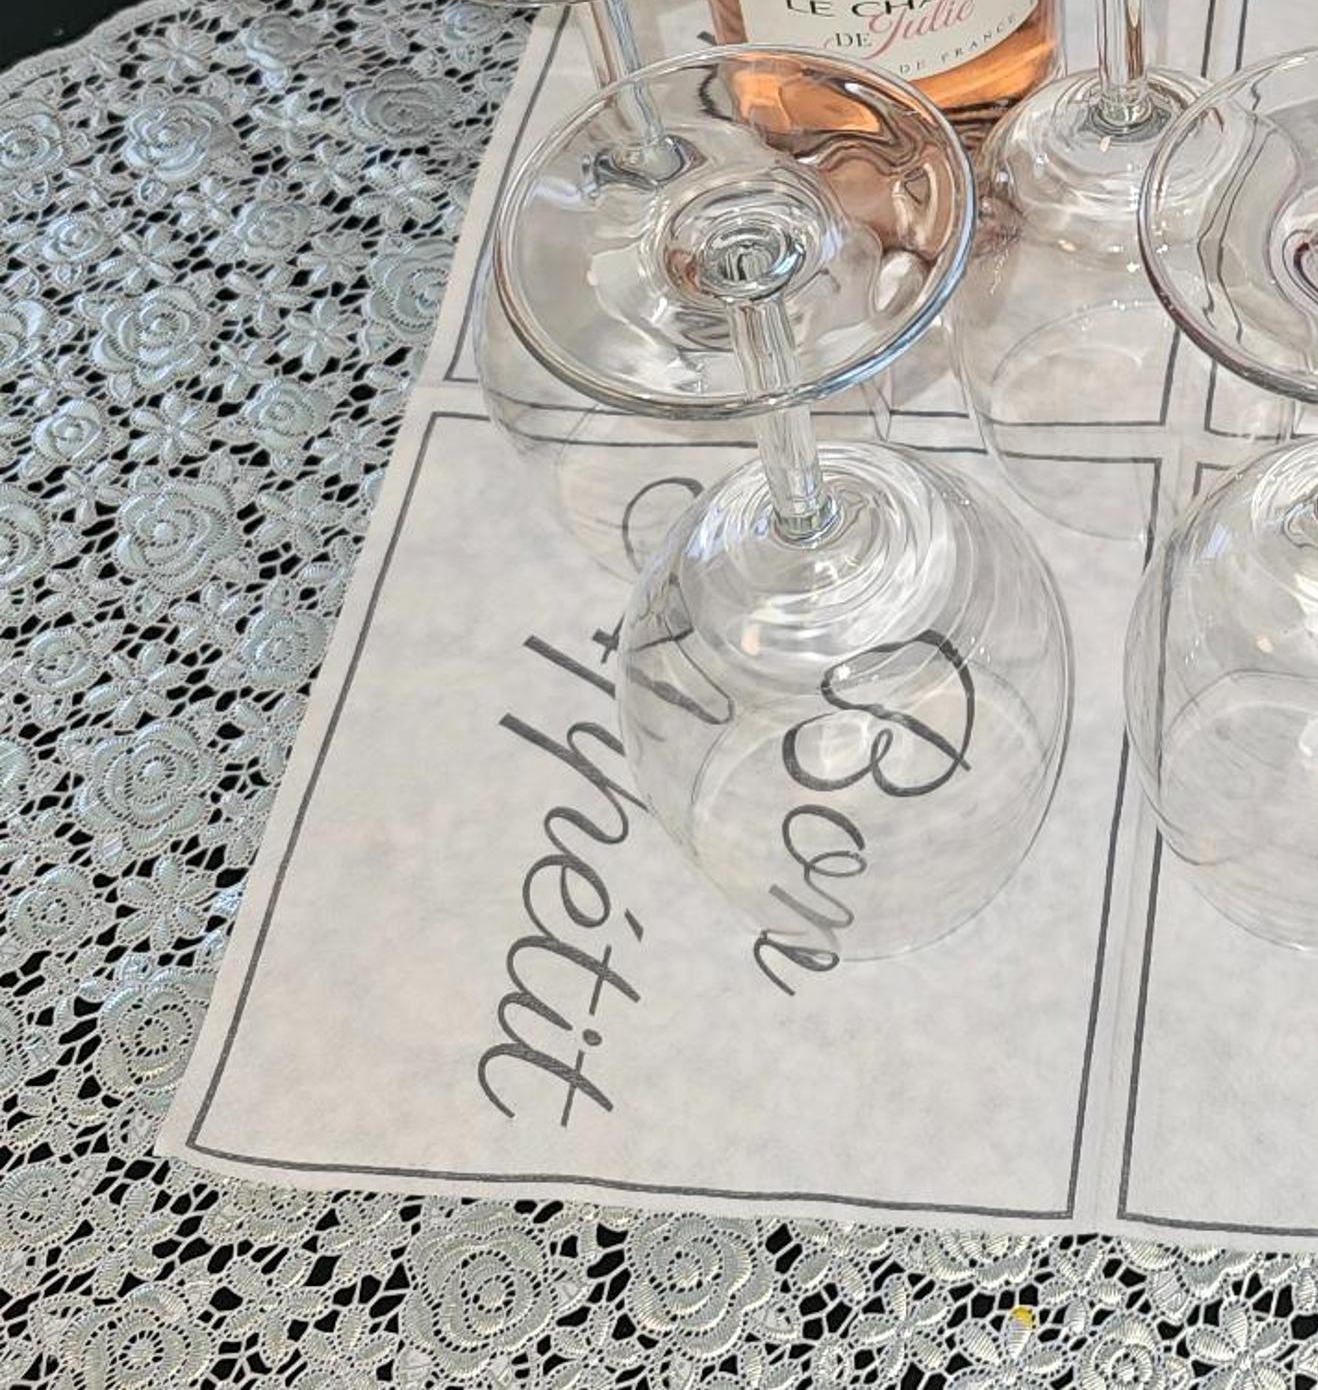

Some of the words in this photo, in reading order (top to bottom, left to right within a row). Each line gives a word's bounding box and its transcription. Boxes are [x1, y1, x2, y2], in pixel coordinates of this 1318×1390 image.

[834, 31, 873, 49] DE
[941, 12, 1018, 65] FRANCE
[753, 628, 975, 997] Bon
